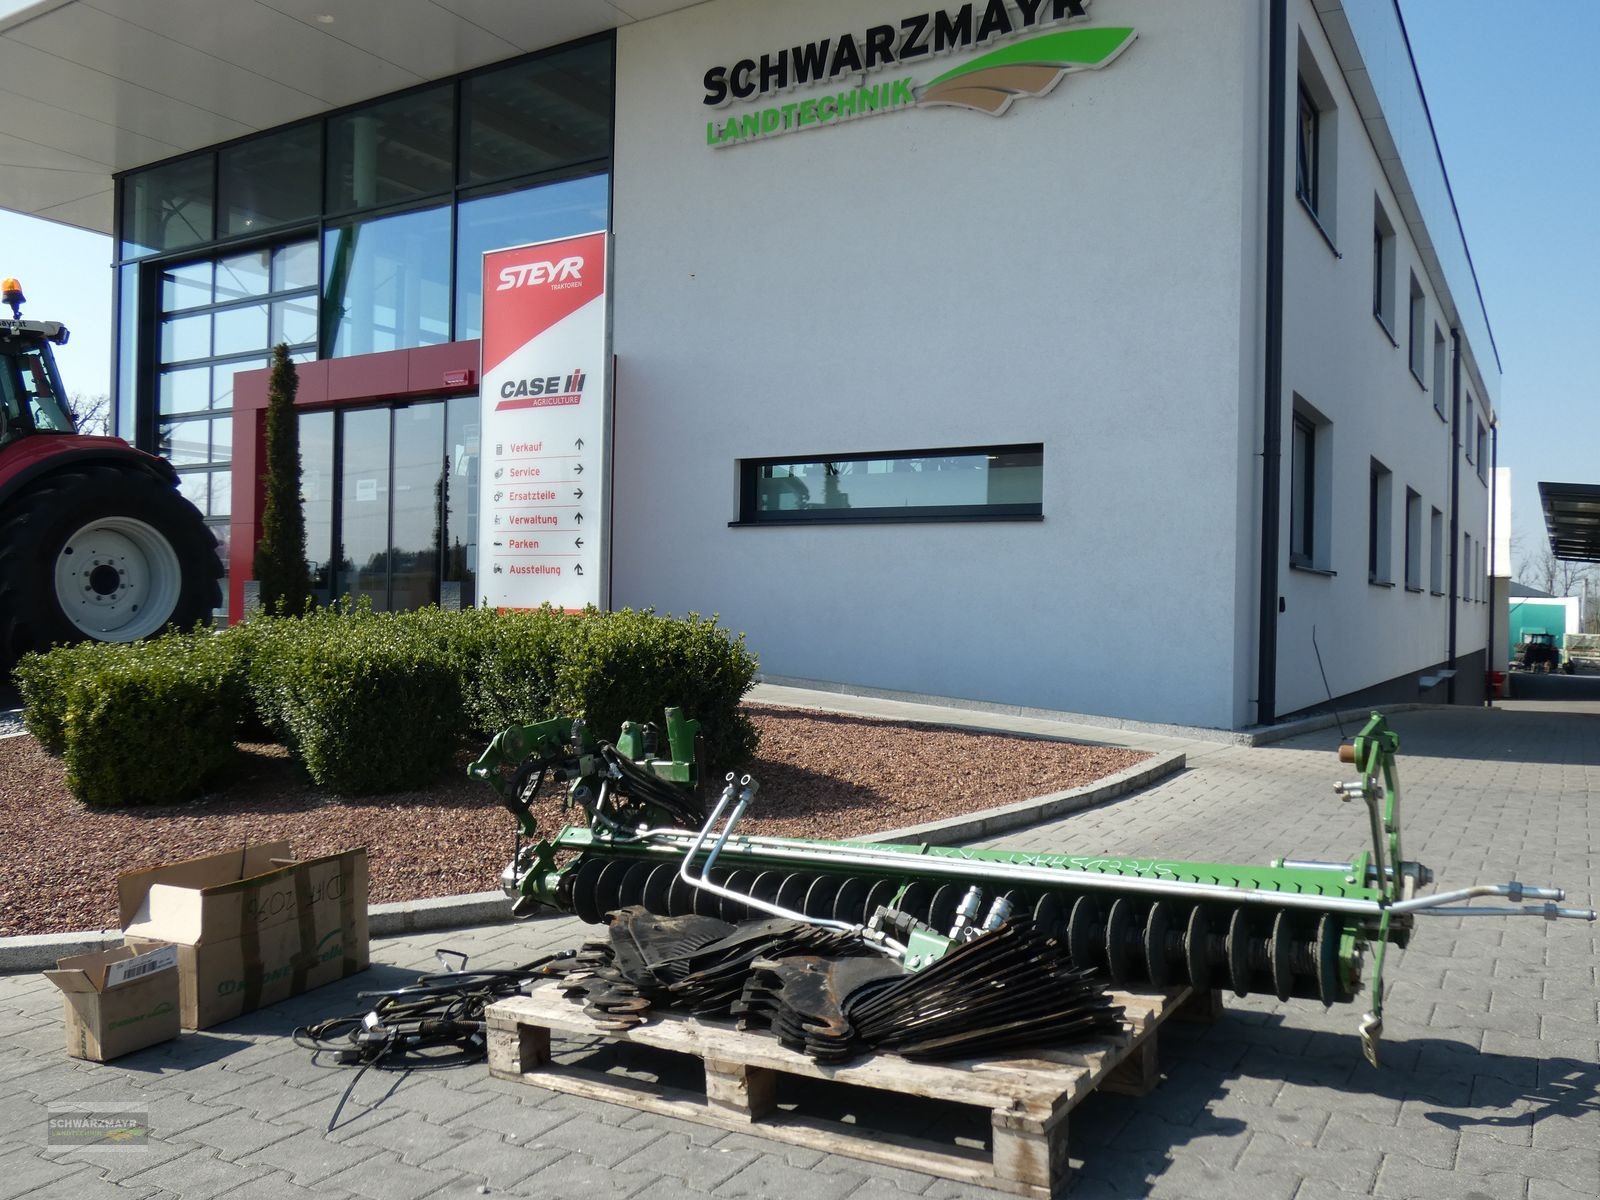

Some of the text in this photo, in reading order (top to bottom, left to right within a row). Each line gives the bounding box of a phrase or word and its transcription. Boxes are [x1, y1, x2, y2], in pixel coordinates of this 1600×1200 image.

[706, 76, 917, 146] LANDTECHNIK
[496, 256, 584, 291] STEYR
[551, 281, 582, 290] TRAKTOREN
[500, 376, 560, 398] CASE
[533, 396, 579, 406] AGRICULTURE
[510, 441, 542, 453] Verkauf
[510, 467, 540, 477] Service
[509, 491, 556, 501] Ersatzteile
[509, 515, 558, 525] Verwaltung
[509, 539, 539, 549] Parken
[509, 565, 561, 576] Ausstellung
